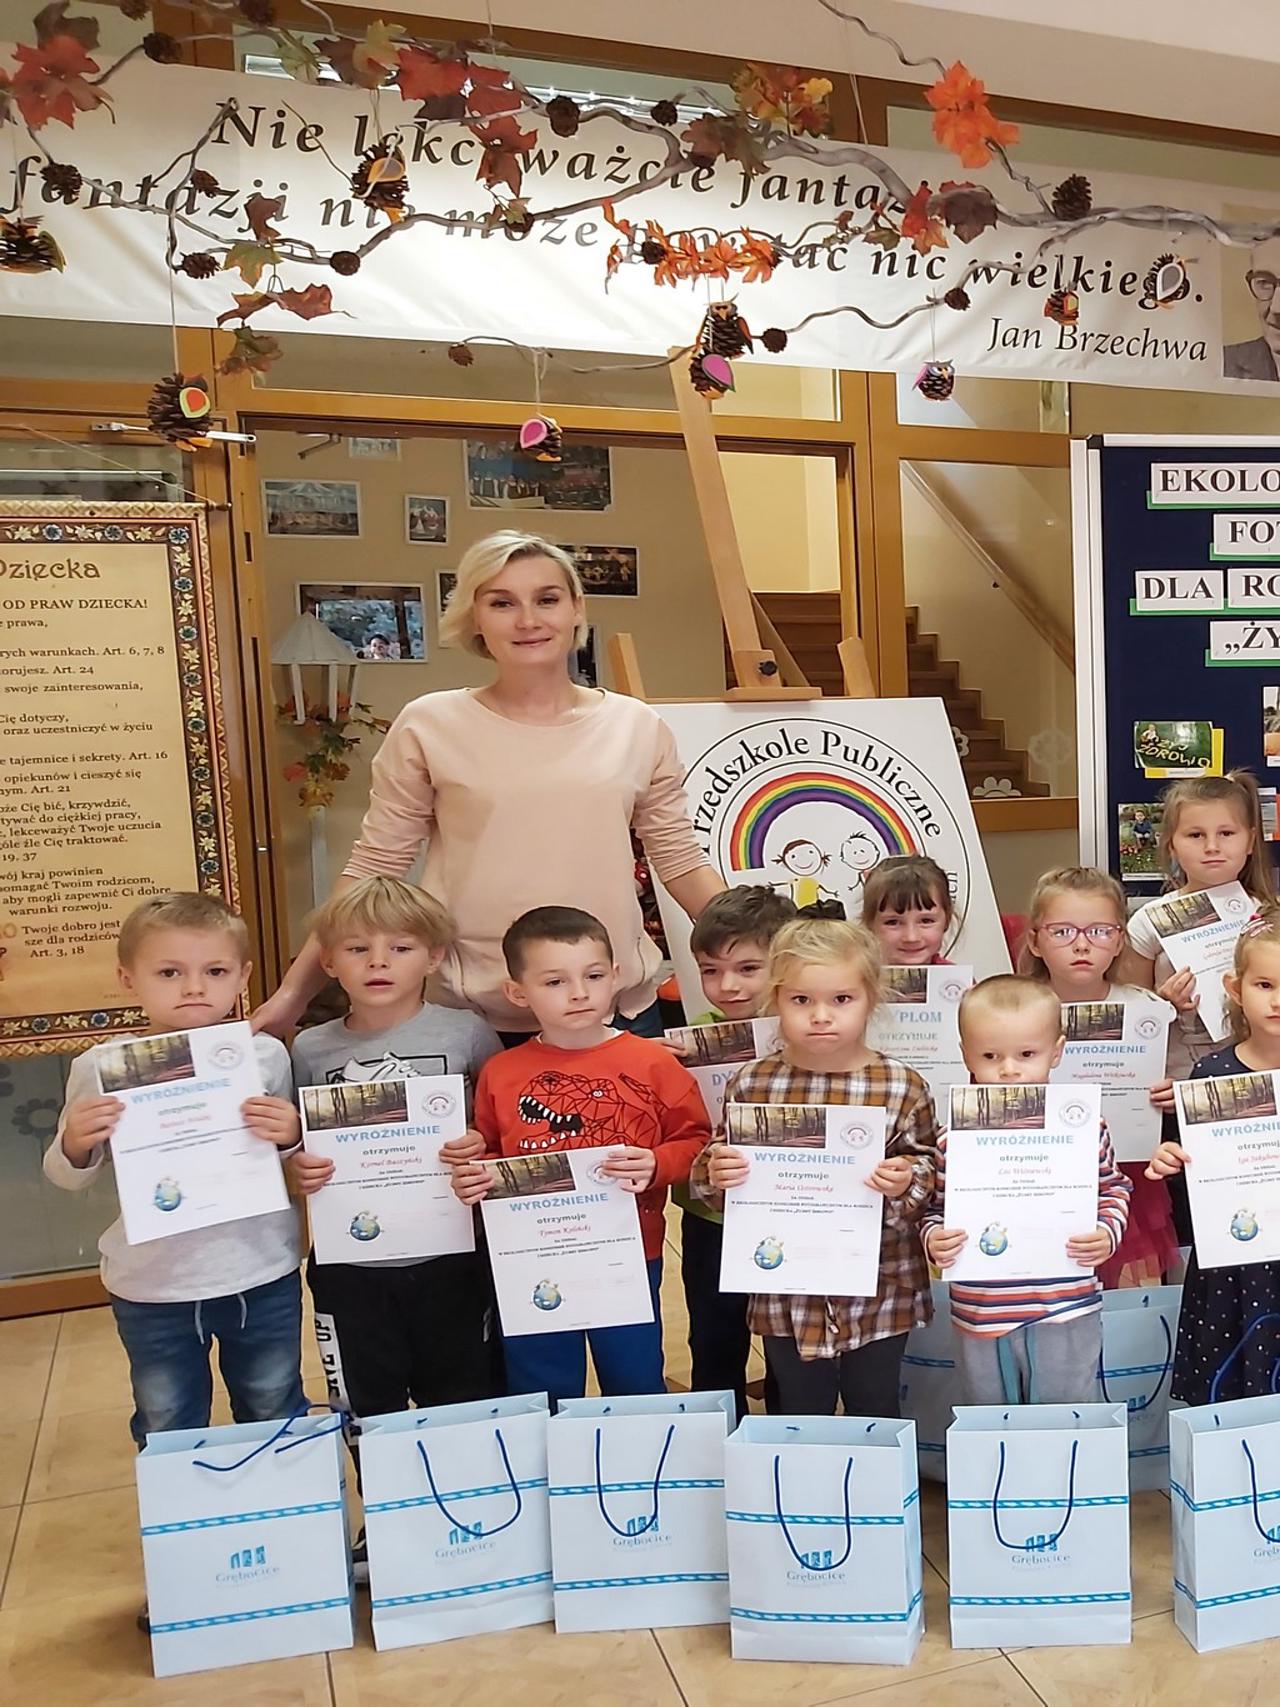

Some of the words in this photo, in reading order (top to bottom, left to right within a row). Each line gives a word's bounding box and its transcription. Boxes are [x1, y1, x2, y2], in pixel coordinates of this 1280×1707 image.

[211, 100, 324, 152] Nie
[354, 115, 715, 193] lkcważce
[871, 248, 946, 281] nic
[968, 252, 1204, 311] wielkie.
[987, 317, 1042, 352] Jan
[1054, 324, 1208, 362] Brzechwa
[1142, 577, 1213, 601] DLA
[3, 600, 25, 609] OD
[30, 600, 74, 609] PRAW
[79, 599, 148, 609] DZIECKA!
[7, 619, 48, 629] prawa,
[30, 648, 99, 657] warunkach.
[102, 647, 125, 656] Art.
[157, 646, 165, 655] 8
[0, 666, 49, 677] orujesz.
[52, 665, 75, 675] Art.
[80, 666, 94, 675] 24
[4, 684, 39, 693] swoje
[43, 682, 143, 693] zainteresowania,
[20, 713, 69, 724] dotyczy,
[3, 727, 30, 736] oraz
[33, 724, 107, 735] uczestniczyć
[123, 722, 153, 733] życiu
[10, 754, 69, 767] tajemnice
[79, 752, 125, 763] sekrety.
[129, 752, 151, 761] Art.
[154, 751, 168, 760] 16
[4, 772, 70, 785] opiekunów
[81, 769, 122, 781] cieszyć
[126, 770, 142, 780] się
[821, 730, 941, 838] Publiczne
[31, 785, 54, 794] Art.
[57, 785, 70, 793] 21
[693, 728, 810, 854] rzedszkole
[20, 802, 40, 813] Cię
[43, 801, 65, 811] bić,
[68, 799, 131, 811] krzywdzić,
[39, 813, 54, 823] do
[57, 811, 102, 823] ciężkiej
[105, 811, 141, 822] pracy,
[9, 825, 76, 837] lekceważyć
[79, 823, 115, 833] Twoje
[118, 822, 161, 831] uczucia
[43, 838, 63, 848] Cię
[66, 834, 128, 845] traktować.
[23, 852, 37, 862] 37
[21, 869, 45, 881] kraj
[49, 867, 103, 881] powinien
[52, 879, 94, 890] Twoim
[3, 894, 25, 905] aby
[28, 892, 61, 904] mogli
[64, 889, 118, 902] zapewnić
[121, 887, 134, 897] Ci
[137, 886, 171, 896] dobre
[9, 905, 59, 916] warunki
[62, 903, 113, 914] rozwoju.
[21, 924, 60, 935] Twoje
[62, 921, 97, 932] dobro
[100, 919, 120, 932] jest
[47, 935, 65, 945] dla
[30, 948, 52, 958] Art.
[71, 946, 85, 955] 18
